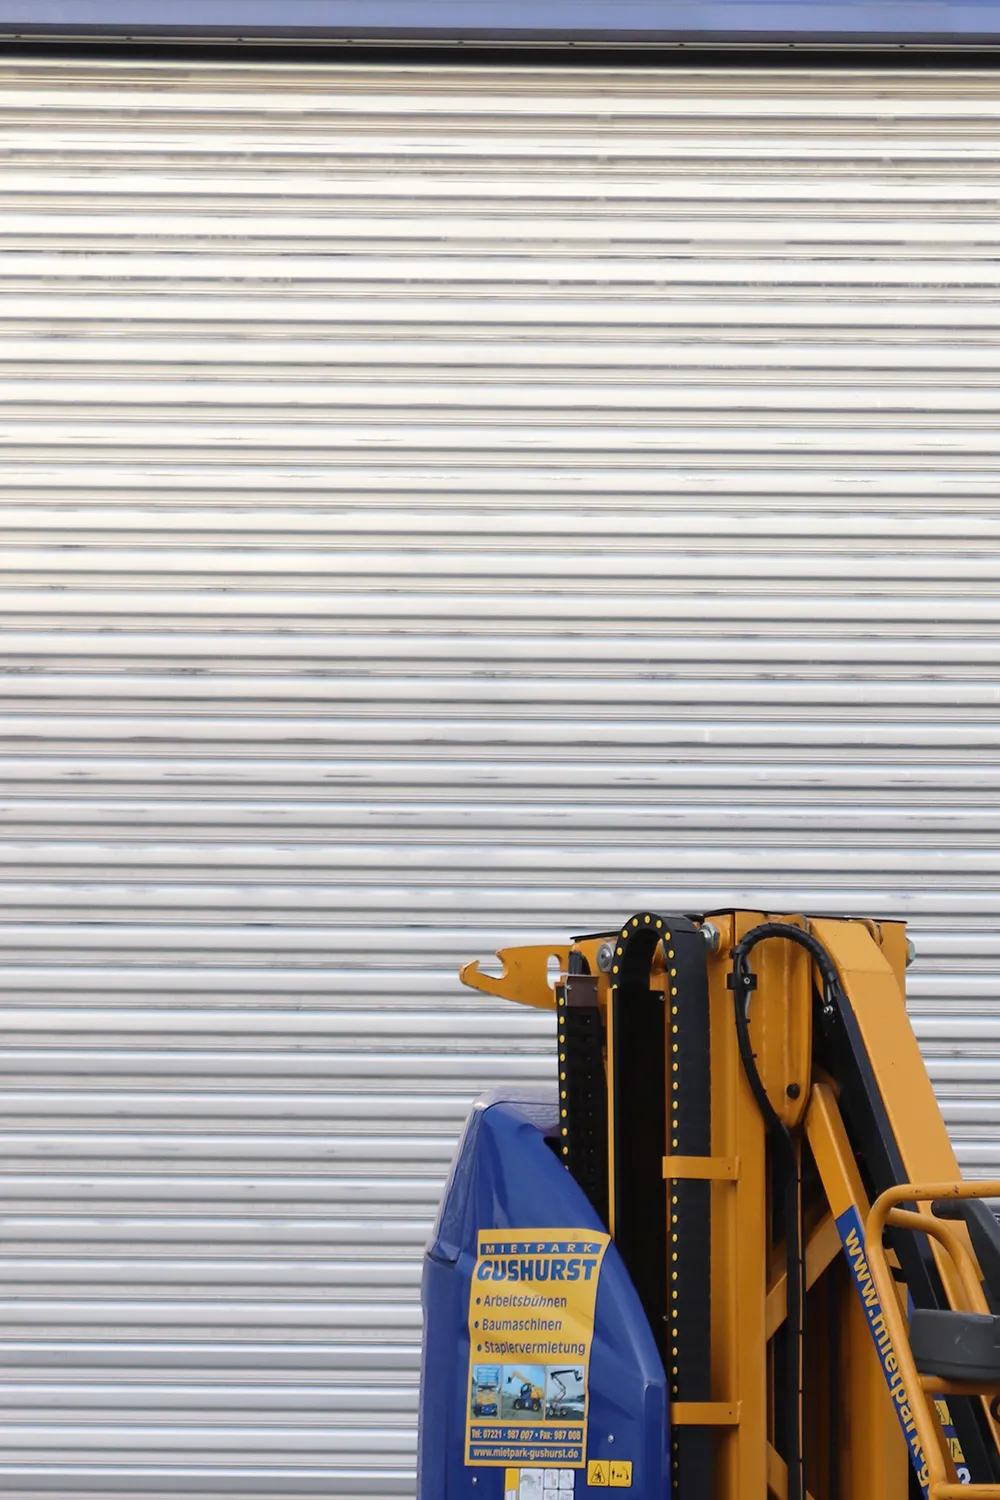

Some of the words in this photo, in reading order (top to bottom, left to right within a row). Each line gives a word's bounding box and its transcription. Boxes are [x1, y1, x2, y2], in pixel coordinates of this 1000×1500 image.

[485, 1243, 593, 1254] MIETPARK
[476, 1258, 597, 1282] GUSHURST
[483, 1294, 567, 1308] Arbeitsbühnen
[482, 1318, 562, 1331] Baumaschinen
[484, 1341, 586, 1356] Staplervermietung
[483, 1429, 502, 1439] 07221
[540, 1430, 553, 1440] Fax:
[473, 1447, 579, 1459] www.mietpark-gushurst.de
